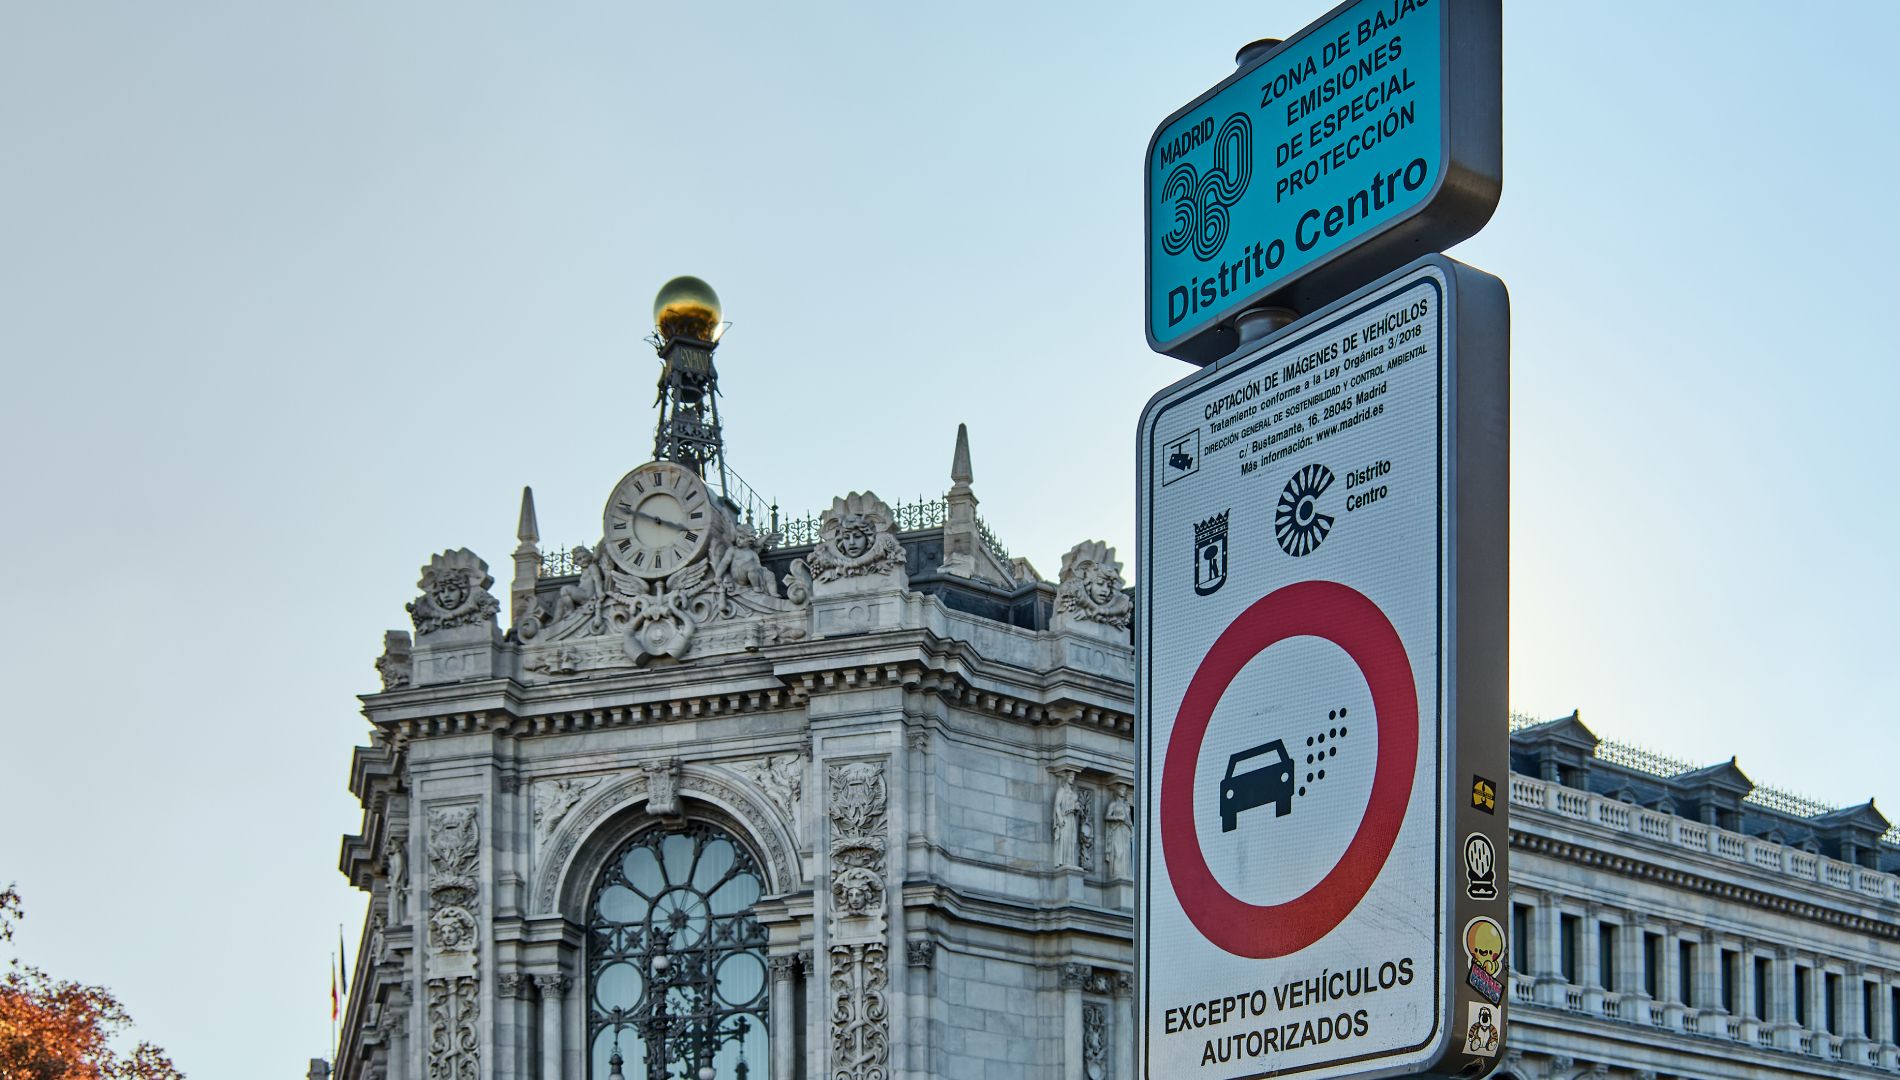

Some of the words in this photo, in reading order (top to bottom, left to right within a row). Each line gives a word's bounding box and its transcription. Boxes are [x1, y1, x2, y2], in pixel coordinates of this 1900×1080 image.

[1260, 55, 1317, 109] ZONA
[1322, 30, 1351, 70] DE
[1358, 0, 1428, 46] BAJA
[1287, 35, 1402, 127] EMISIONES
[1160, 116, 1215, 170] MADRID
[1276, 137, 1304, 168] DE
[1309, 68, 1415, 149] ESPECIAL
[1276, 100, 1415, 204] PROTECCIÓN
[1168, 238, 1285, 328] Distrito
[1295, 157, 1427, 252] Centro
[1204, 379, 1260, 420] CAPTACIÓN
[1264, 371, 1279, 391] DE
[1283, 342, 1338, 383] IMÁGENES
[1342, 332, 1358, 354] DE
[1362, 299, 1428, 344] VEHÍCULOS
[1204, 431, 1239, 456] DIRECCIÓN
[1241, 420, 1271, 439] GENERAL
[1273, 411, 1283, 423] DE
[1285, 385, 1341, 418] SOSTENIBILIDAD
[1343, 380, 1349, 391] Y
[1350, 364, 1385, 388] CONTROL
[1386, 344, 1427, 372] AMBIENTAL
[1210, 405, 1257, 434] Tratamiento
[1260, 384, 1301, 410] conforme
[1304, 380, 1310, 389] a
[1313, 374, 1321, 386] la
[1324, 364, 1340, 381] Ley
[1343, 344, 1384, 371] Orgánica
[1387, 324, 1422, 350] 3/2018
[1239, 443, 1249, 459] c/
[1252, 423, 1305, 453] Bustamante,
[1323, 397, 1353, 420] 28045
[1356, 381, 1387, 406] Madrid
[1241, 460, 1258, 476] Más
[1261, 435, 1313, 467] información:
[1316, 403, 1384, 441] www.madrid.es
[1346, 459, 1391, 490] Distrito
[1346, 484, 1388, 512] Centro
[1165, 989, 1266, 1034] EXCEPTO
[1273, 957, 1414, 1011] VEHÍCULOS
[1200, 1009, 1369, 1066] AUTORIZADOS
